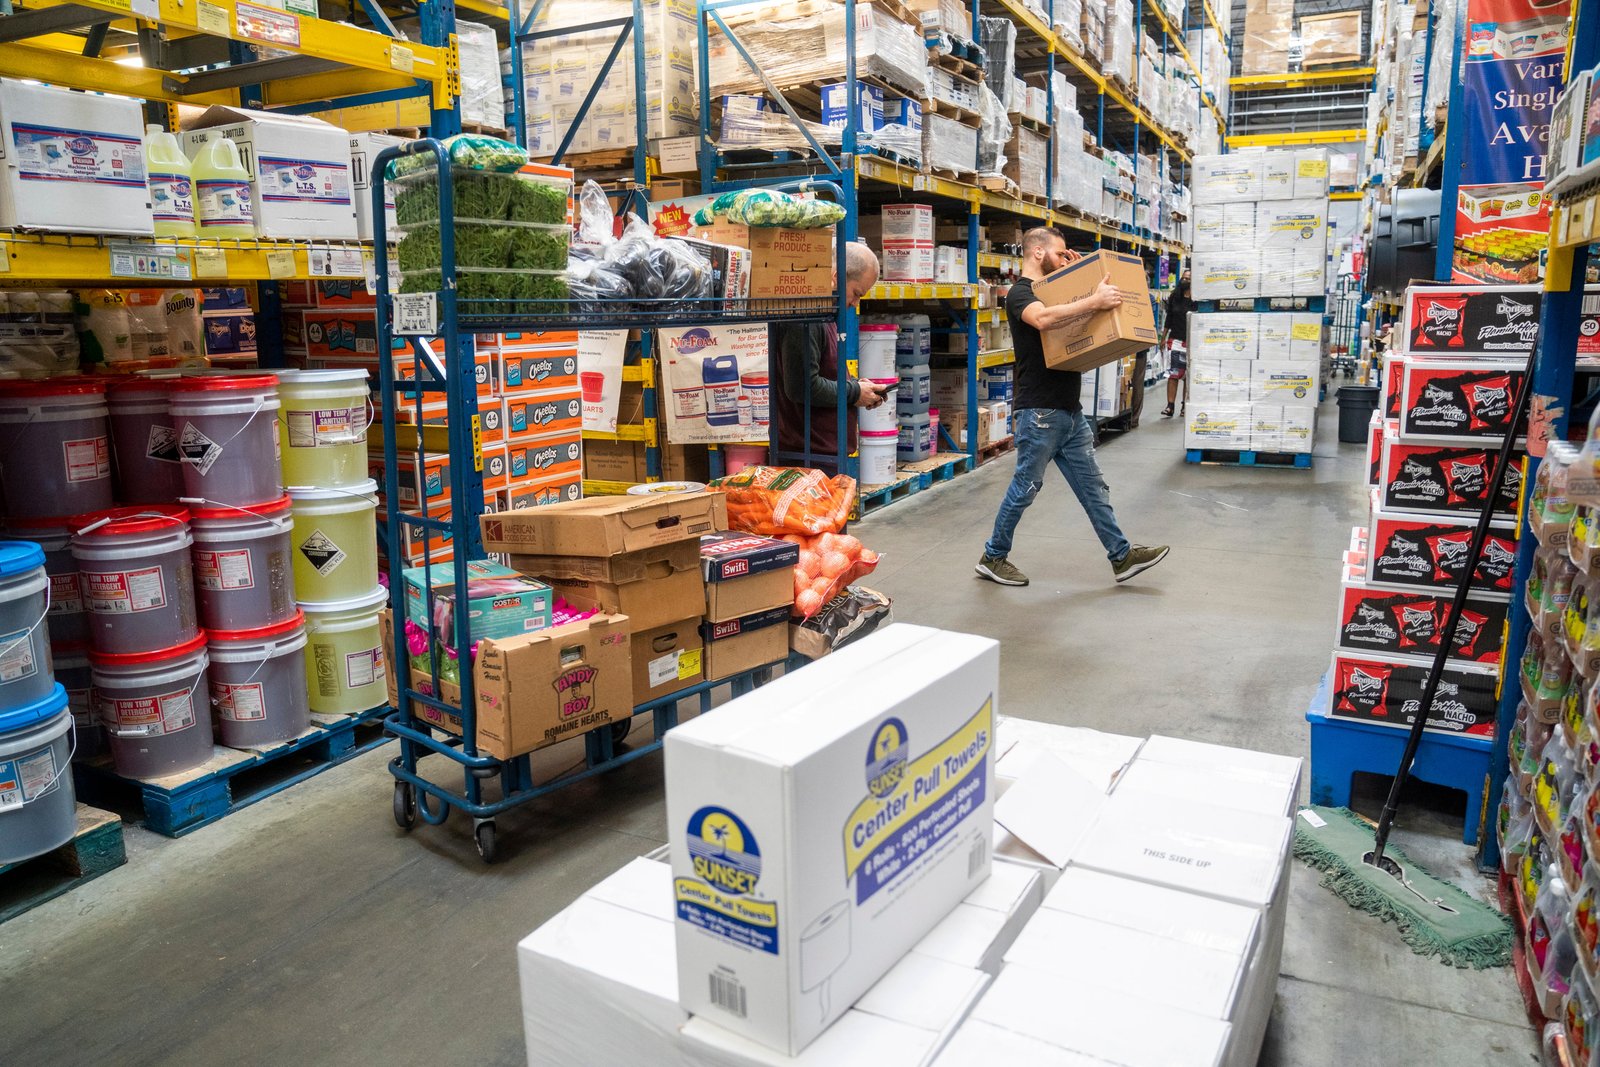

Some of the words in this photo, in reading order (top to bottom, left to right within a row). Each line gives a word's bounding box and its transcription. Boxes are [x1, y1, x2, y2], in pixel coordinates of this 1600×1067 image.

[1514, 56, 1567, 81] Vari
[226, 127, 245, 139] BOTTLES
[1490, 121, 1551, 146] Ava
[296, 182, 316, 190] L.T.S.
[660, 209, 681, 223] NEW
[658, 224, 688, 235] RESTAURANT
[779, 232, 806, 242] FRESH
[774, 242, 811, 253] PRODUCE
[727, 251, 737, 286] ISLANDS
[779, 275, 806, 285] FRESH
[774, 285, 812, 295] PRODUCE
[165, 296, 195, 316] Bounty
[1496, 302, 1533, 316] Doritos
[1428, 307, 1458, 320] Doritos
[741, 326, 767, 334] Hallmark
[1583, 321, 1596, 330] 50
[731, 342, 754, 350] Washing
[755, 340, 766, 348] and
[529, 359, 553, 380] Cheetos
[1425, 389, 1454, 400] Doritos
[1475, 387, 1505, 401] Doritos
[318, 410, 332, 418] LOW
[333, 409, 348, 418] TEMP
[534, 403, 557, 424] Cheetos
[582, 405, 604, 414] UARTS
[1488, 409, 1505, 417] NACHO
[319, 416, 347, 426] SANITIZER
[487, 415, 497, 423] 44
[1443, 412, 1467, 422] NACHO
[534, 446, 558, 469] Cheetos
[568, 447, 577, 455] 44
[491, 461, 501, 470] 44
[1404, 465, 1432, 476] Doritos
[1451, 465, 1482, 477] Doritos
[568, 486, 577, 494] 44
[1422, 486, 1445, 497] NACHO
[1465, 485, 1480, 493] NACHO
[1502, 491, 1517, 499] NACHO
[504, 524, 536, 534] AMERICAN
[504, 534, 518, 542] FOODS
[518, 534, 536, 543] GROUP
[1391, 542, 1419, 552] Doritos
[1438, 543, 1468, 553] Doritos
[1485, 545, 1515, 562] Doritos
[724, 561, 746, 575] Swift
[1408, 562, 1431, 573] NACHO
[1487, 568, 1502, 577] NACHO
[102, 574, 119, 583] TEMP
[91, 582, 121, 591] DETERGENT
[1358, 608, 1385, 619] Doritos
[1403, 612, 1432, 623] Doritos
[715, 623, 737, 636] Swift
[1375, 630, 1397, 640] NACHO
[1416, 630, 1431, 638] NACHO
[481, 660, 502, 671] Romaine
[483, 671, 501, 681] Hearts
[559, 669, 594, 692] ANDY
[1352, 675, 1382, 689] Doritos
[119, 699, 132, 708] LOW
[134, 699, 153, 708] TEMP
[564, 696, 591, 716] BOY
[1358, 697, 1375, 705] NACHO
[120, 705, 155, 715] DETERGENT
[425, 706, 442, 721] BOY
[1444, 709, 1477, 724] NACHO
[544, 719, 579, 739] ROMAINE
[580, 709, 609, 726] HEARTS
[1431, 719, 1448, 727] Tortilla
[1447, 722, 1464, 730] Chips
[869, 761, 908, 797] SUNSET
[853, 791, 909, 849] Center
[913, 766, 940, 802] Pull
[944, 728, 988, 782] Towels
[873, 844, 896, 871] Rolls
[918, 793, 958, 835] Perforated
[957, 777, 981, 802] Sheets
[876, 858, 902, 885] White
[933, 811, 958, 839] Center
[957, 796, 973, 819] Pull
[1142, 847, 1169, 861] THIS
[1169, 853, 1194, 866] SIDE
[1195, 858, 1212, 868] UP
[694, 856, 758, 896] SUNSET
[680, 884, 711, 900] Center
[714, 896, 734, 910] Pull
[736, 903, 773, 922] Towels
[750, 928, 773, 944] Sheets
